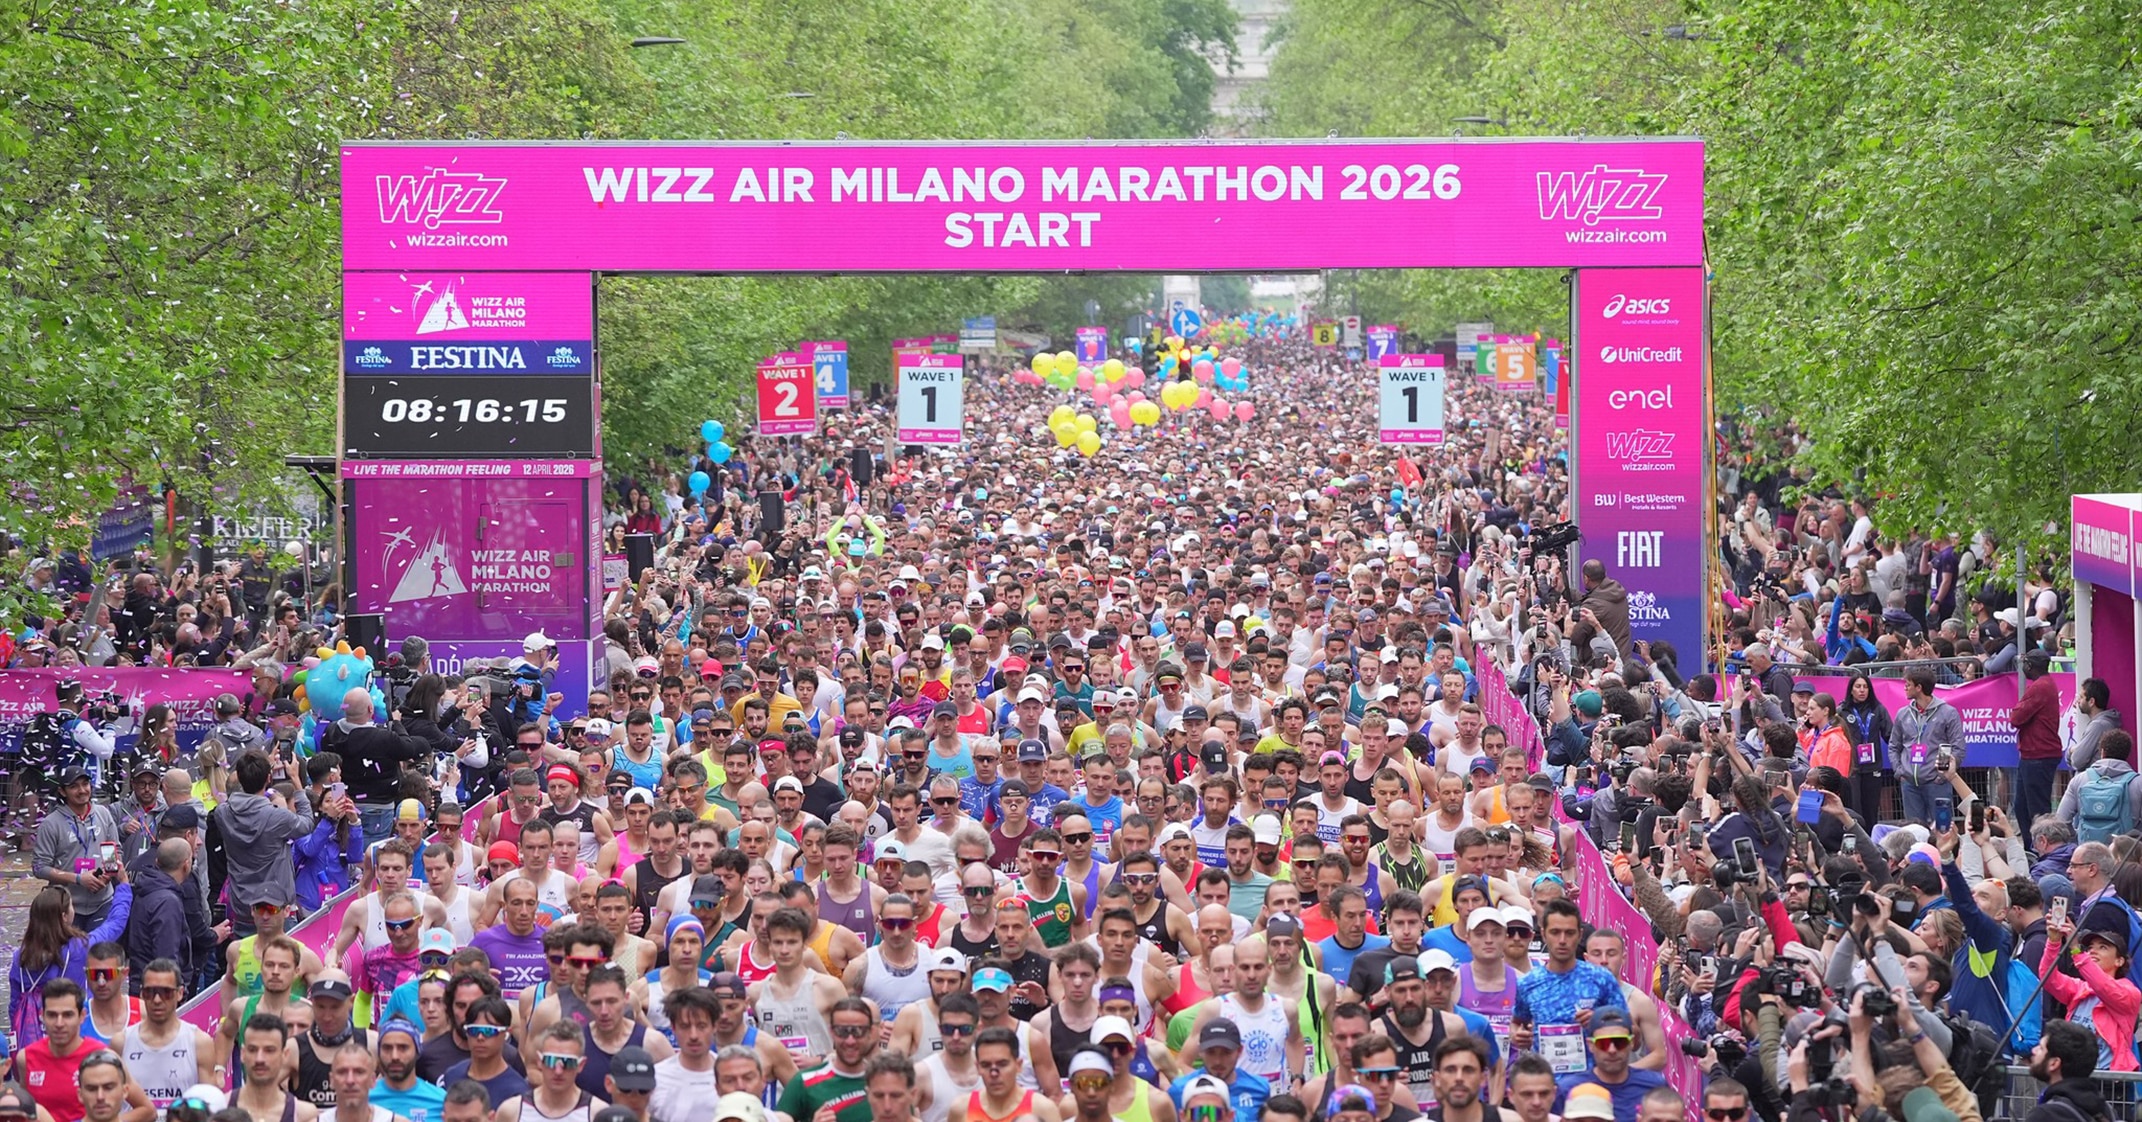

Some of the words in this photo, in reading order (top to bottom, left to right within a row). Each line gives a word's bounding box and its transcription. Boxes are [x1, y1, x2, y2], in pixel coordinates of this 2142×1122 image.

[583, 167, 714, 203] WIZZ
[729, 167, 815, 203] AIR
[832, 166, 1025, 203] MILANO
[1042, 165, 1324, 203] MARATHON
[1340, 164, 1462, 200] 2026
[944, 212, 1101, 248] START
[1564, 228, 1667, 245] wizzair.com
[406, 232, 508, 248] wizzair.com
[472, 297, 502, 307] WIZZ
[505, 297, 525, 307] AIR
[1625, 299, 1670, 315] asics
[472, 308, 526, 318] MILANO
[1320, 330, 1329, 343] 8
[1375, 340, 1389, 359] 7
[1618, 347, 1682, 363] UniCredit
[356, 356, 389, 364] FESTINA
[411, 346, 526, 369] FESTINA
[547, 356, 581, 364] FESTINA
[762, 369, 798, 380] WAVE
[799, 368, 806, 379] 1
[1507, 356, 1524, 379] 5
[817, 365, 836, 393] 4
[908, 373, 945, 382] WAVE
[949, 373, 954, 382] 1
[1389, 372, 1427, 382] WAVE
[1431, 372, 1436, 381] 1
[774, 382, 799, 417] 2
[1609, 385, 1673, 409] enel
[382, 399, 567, 423] 08:16:15
[921, 387, 937, 422] 1
[1402, 386, 1418, 423] 1
[354, 465, 378, 475] LIVE
[381, 465, 400, 475] THE
[403, 464, 463, 475] MARATHON
[466, 464, 511, 475] FEELING
[523, 465, 532, 475] 12
[533, 465, 552, 475] APRIL
[553, 464, 574, 475] 2026
[1622, 463, 1675, 471] wizzair.com
[1594, 494, 1616, 506] BW
[1624, 494, 1645, 503] Best
[1646, 494, 1685, 503] Western
[1618, 531, 1664, 567] FIAT
[471, 550, 515, 562] WIZZ
[521, 550, 550, 562] AIR
[471, 565, 551, 579] MILANO
[471, 582, 550, 593] MARATHON
[1629, 607, 1670, 620] STINA
[1962, 708, 1992, 719] WIZZ
[130, 1052, 143, 1060] CT
[172, 1050, 187, 1058] CT
[1411, 1051, 1430, 1064] AIR
